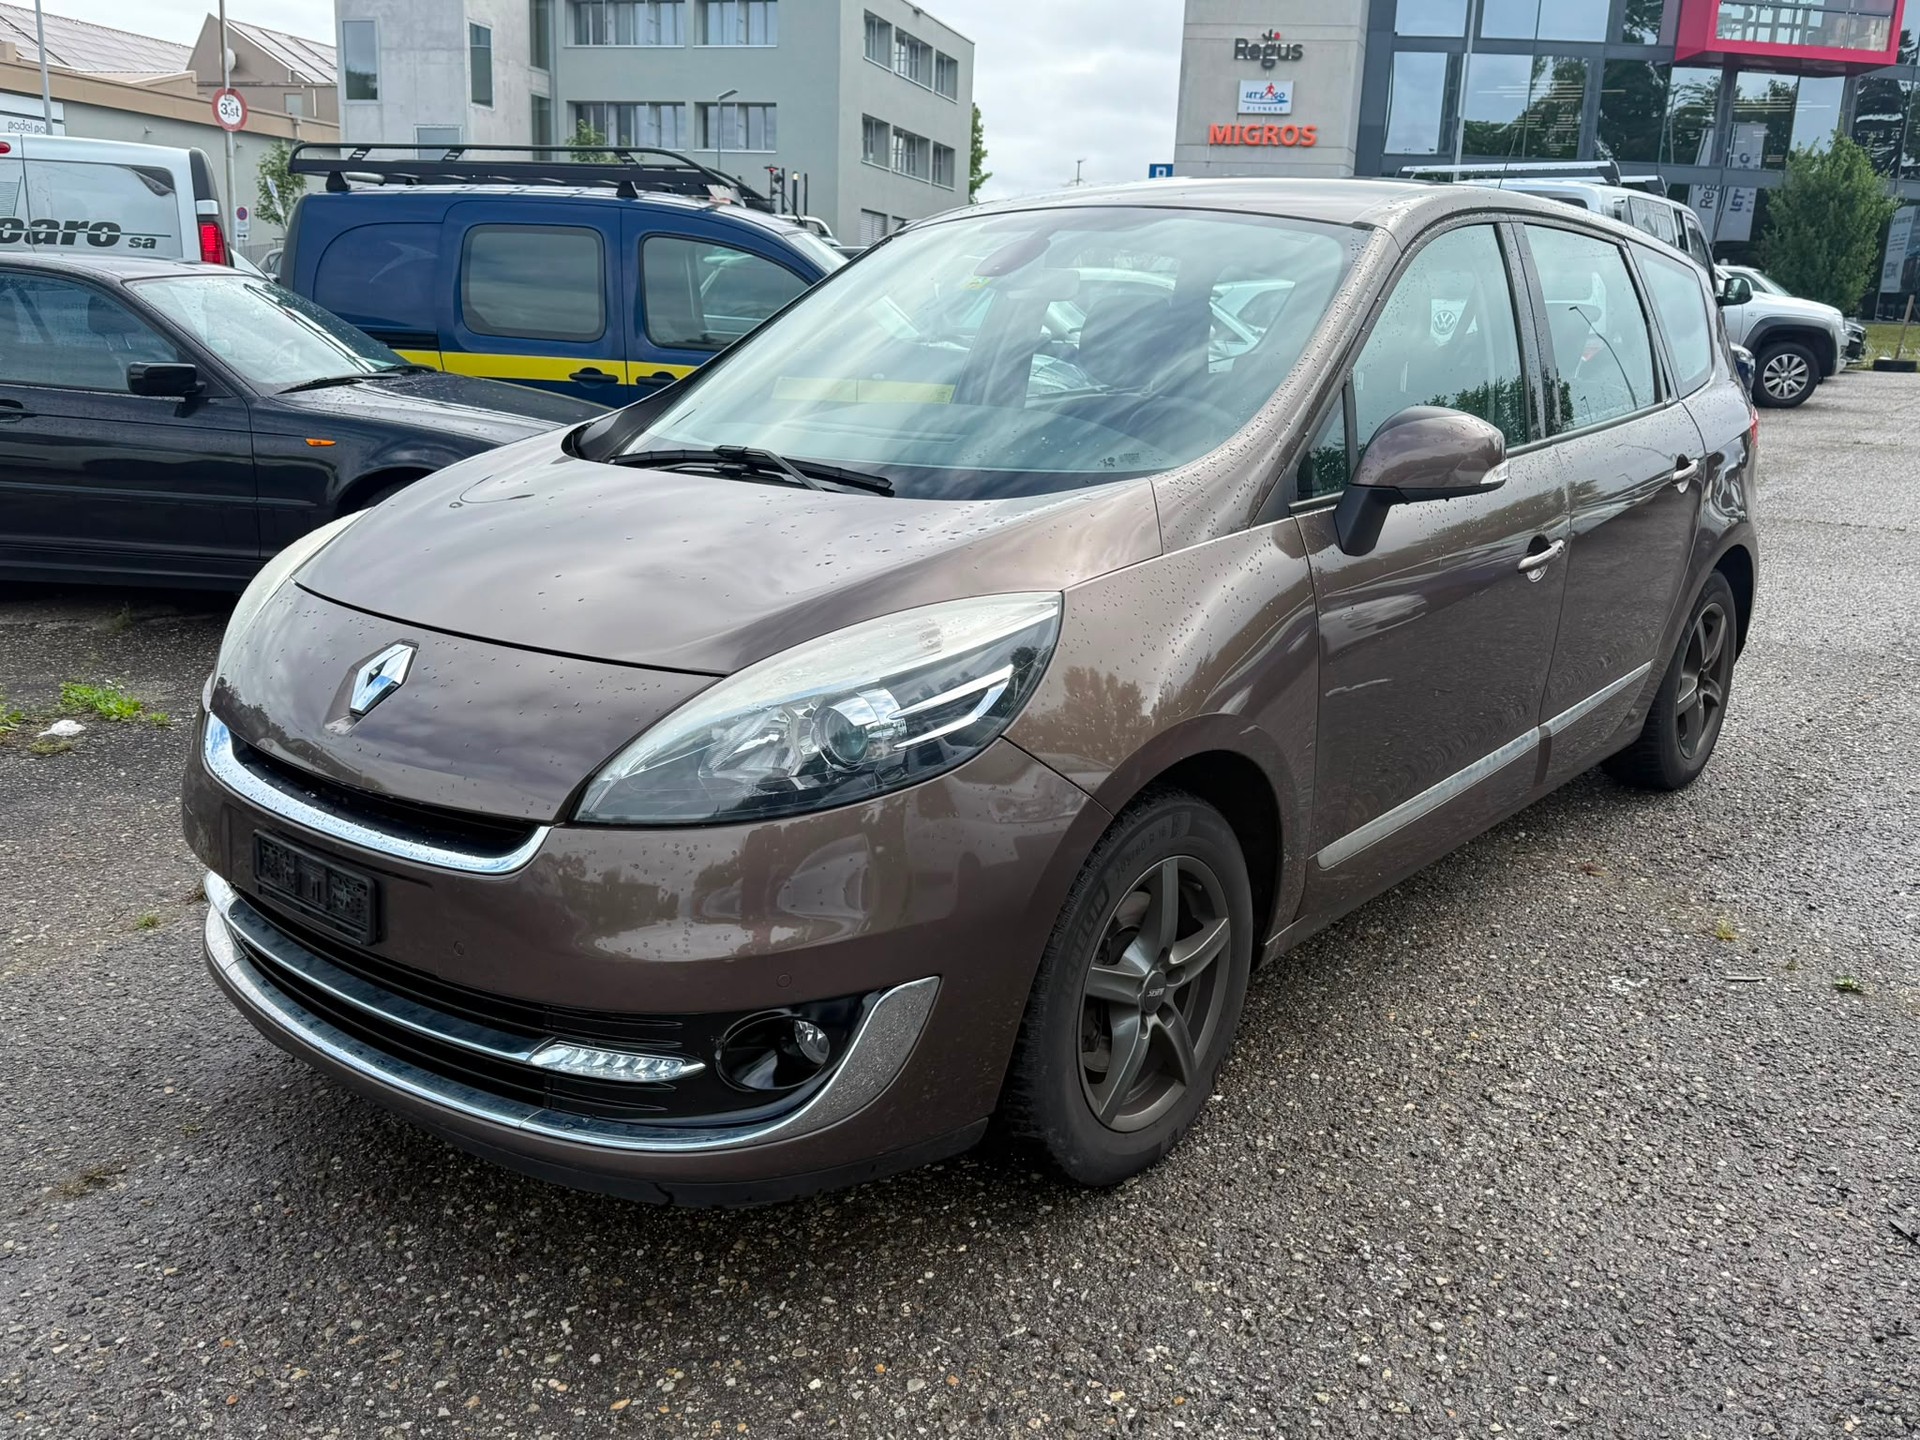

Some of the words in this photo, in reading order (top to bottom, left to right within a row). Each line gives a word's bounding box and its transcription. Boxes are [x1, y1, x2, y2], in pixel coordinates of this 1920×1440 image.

[1234, 38, 1303, 70] Regus
[1208, 123, 1317, 147] MIGROS
[1729, 188, 1746, 212] LET'
[128, 237, 157, 249] sa
